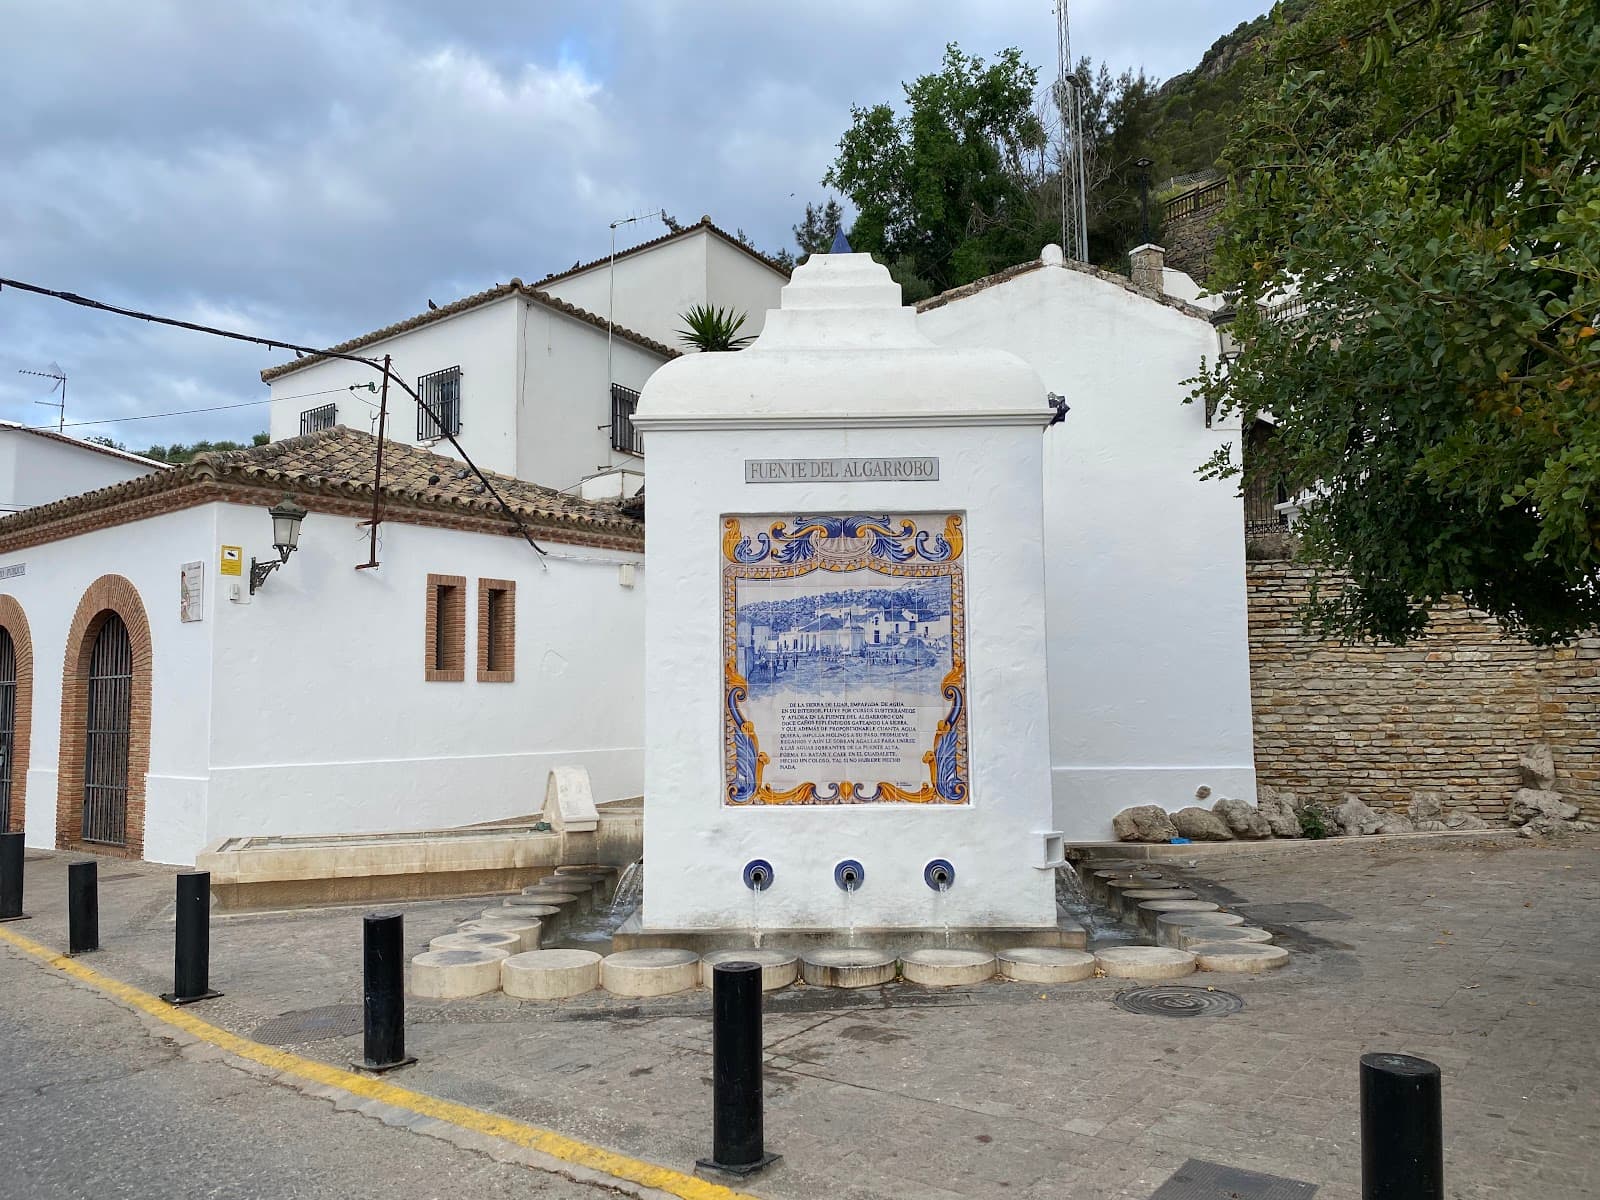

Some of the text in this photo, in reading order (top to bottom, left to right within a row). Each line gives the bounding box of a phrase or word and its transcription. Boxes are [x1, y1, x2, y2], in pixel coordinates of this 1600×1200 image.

[751, 460, 934, 479] FUENTE DEL ALGARROBO
